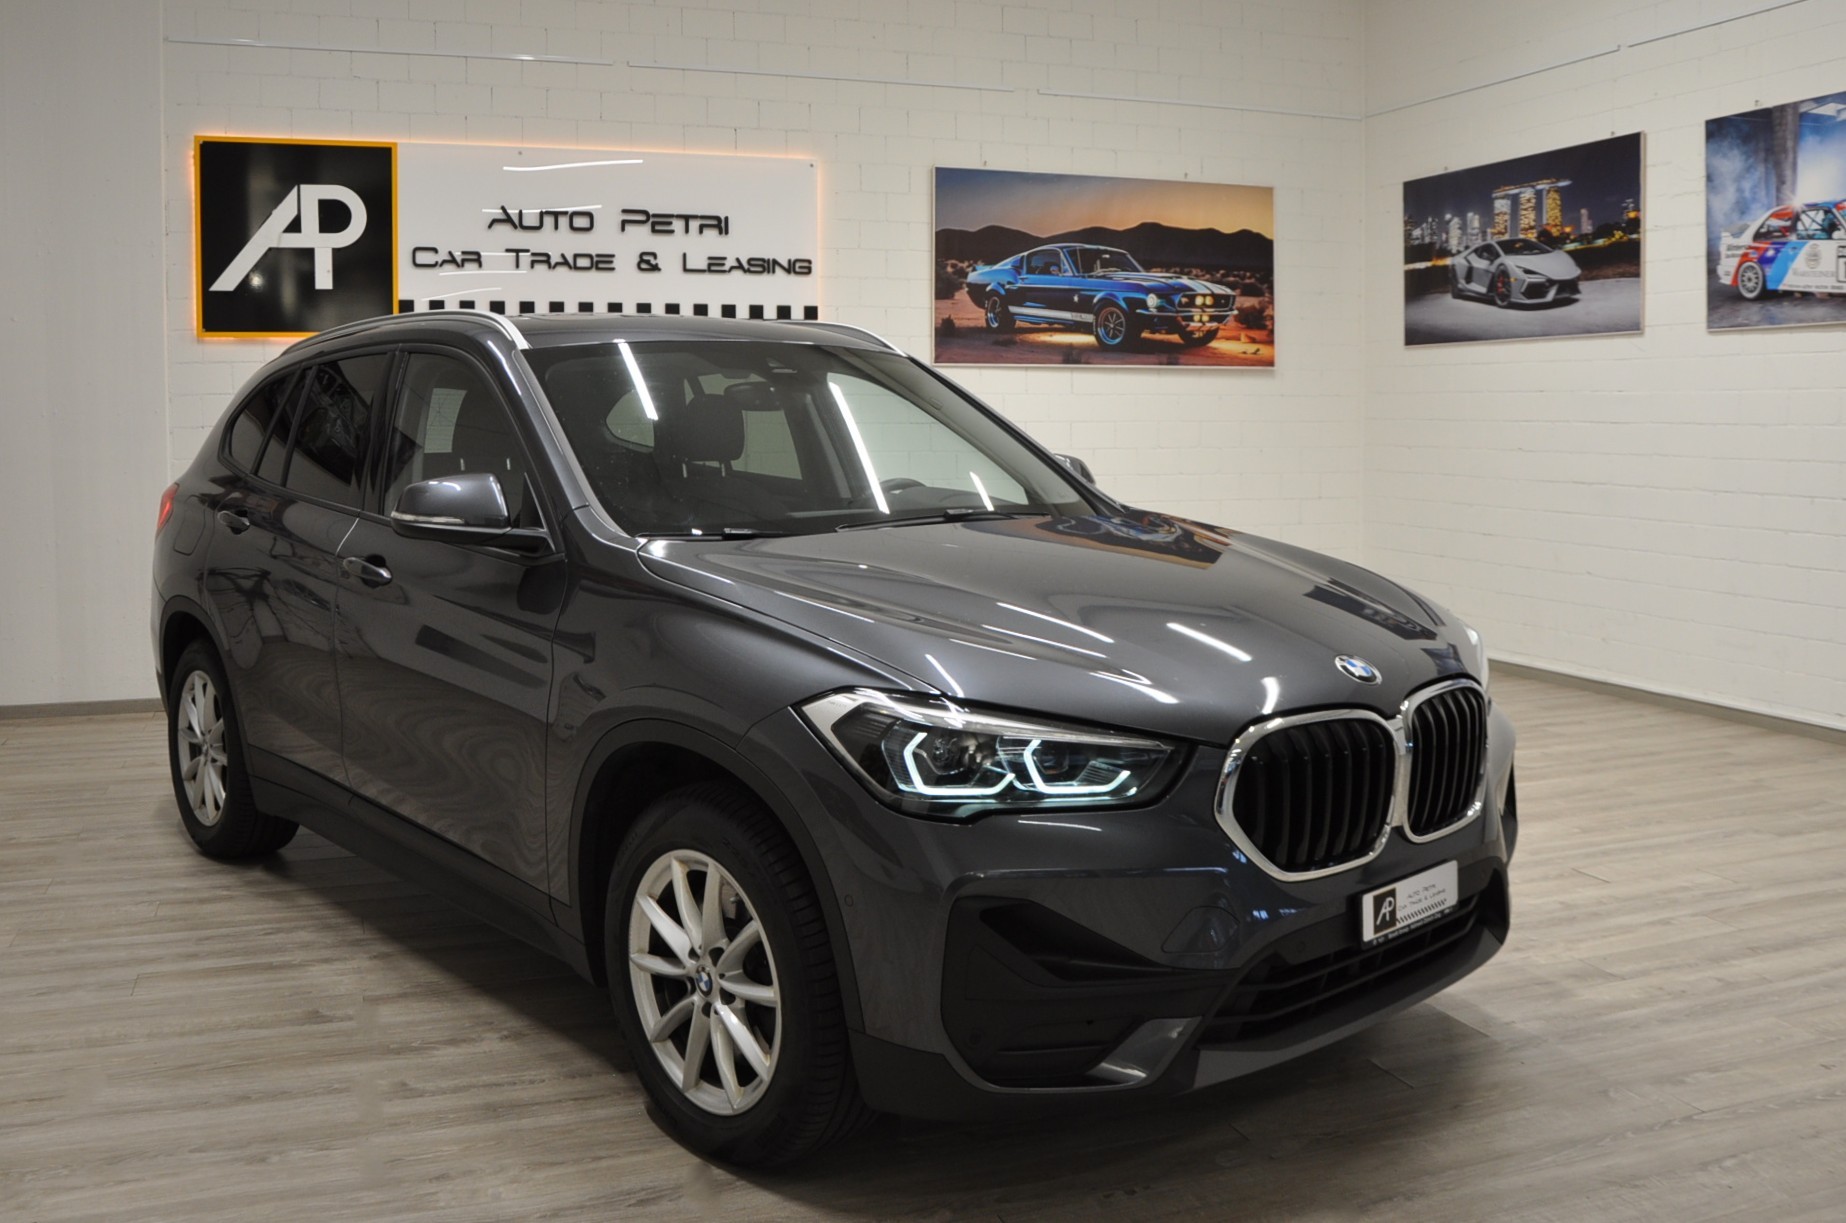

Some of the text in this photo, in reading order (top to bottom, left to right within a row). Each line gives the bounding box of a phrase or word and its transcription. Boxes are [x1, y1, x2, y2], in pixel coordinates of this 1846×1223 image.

[488, 206, 730, 235] AUTO PETRI
[411, 246, 813, 276] CAR TRADE & LEASING
